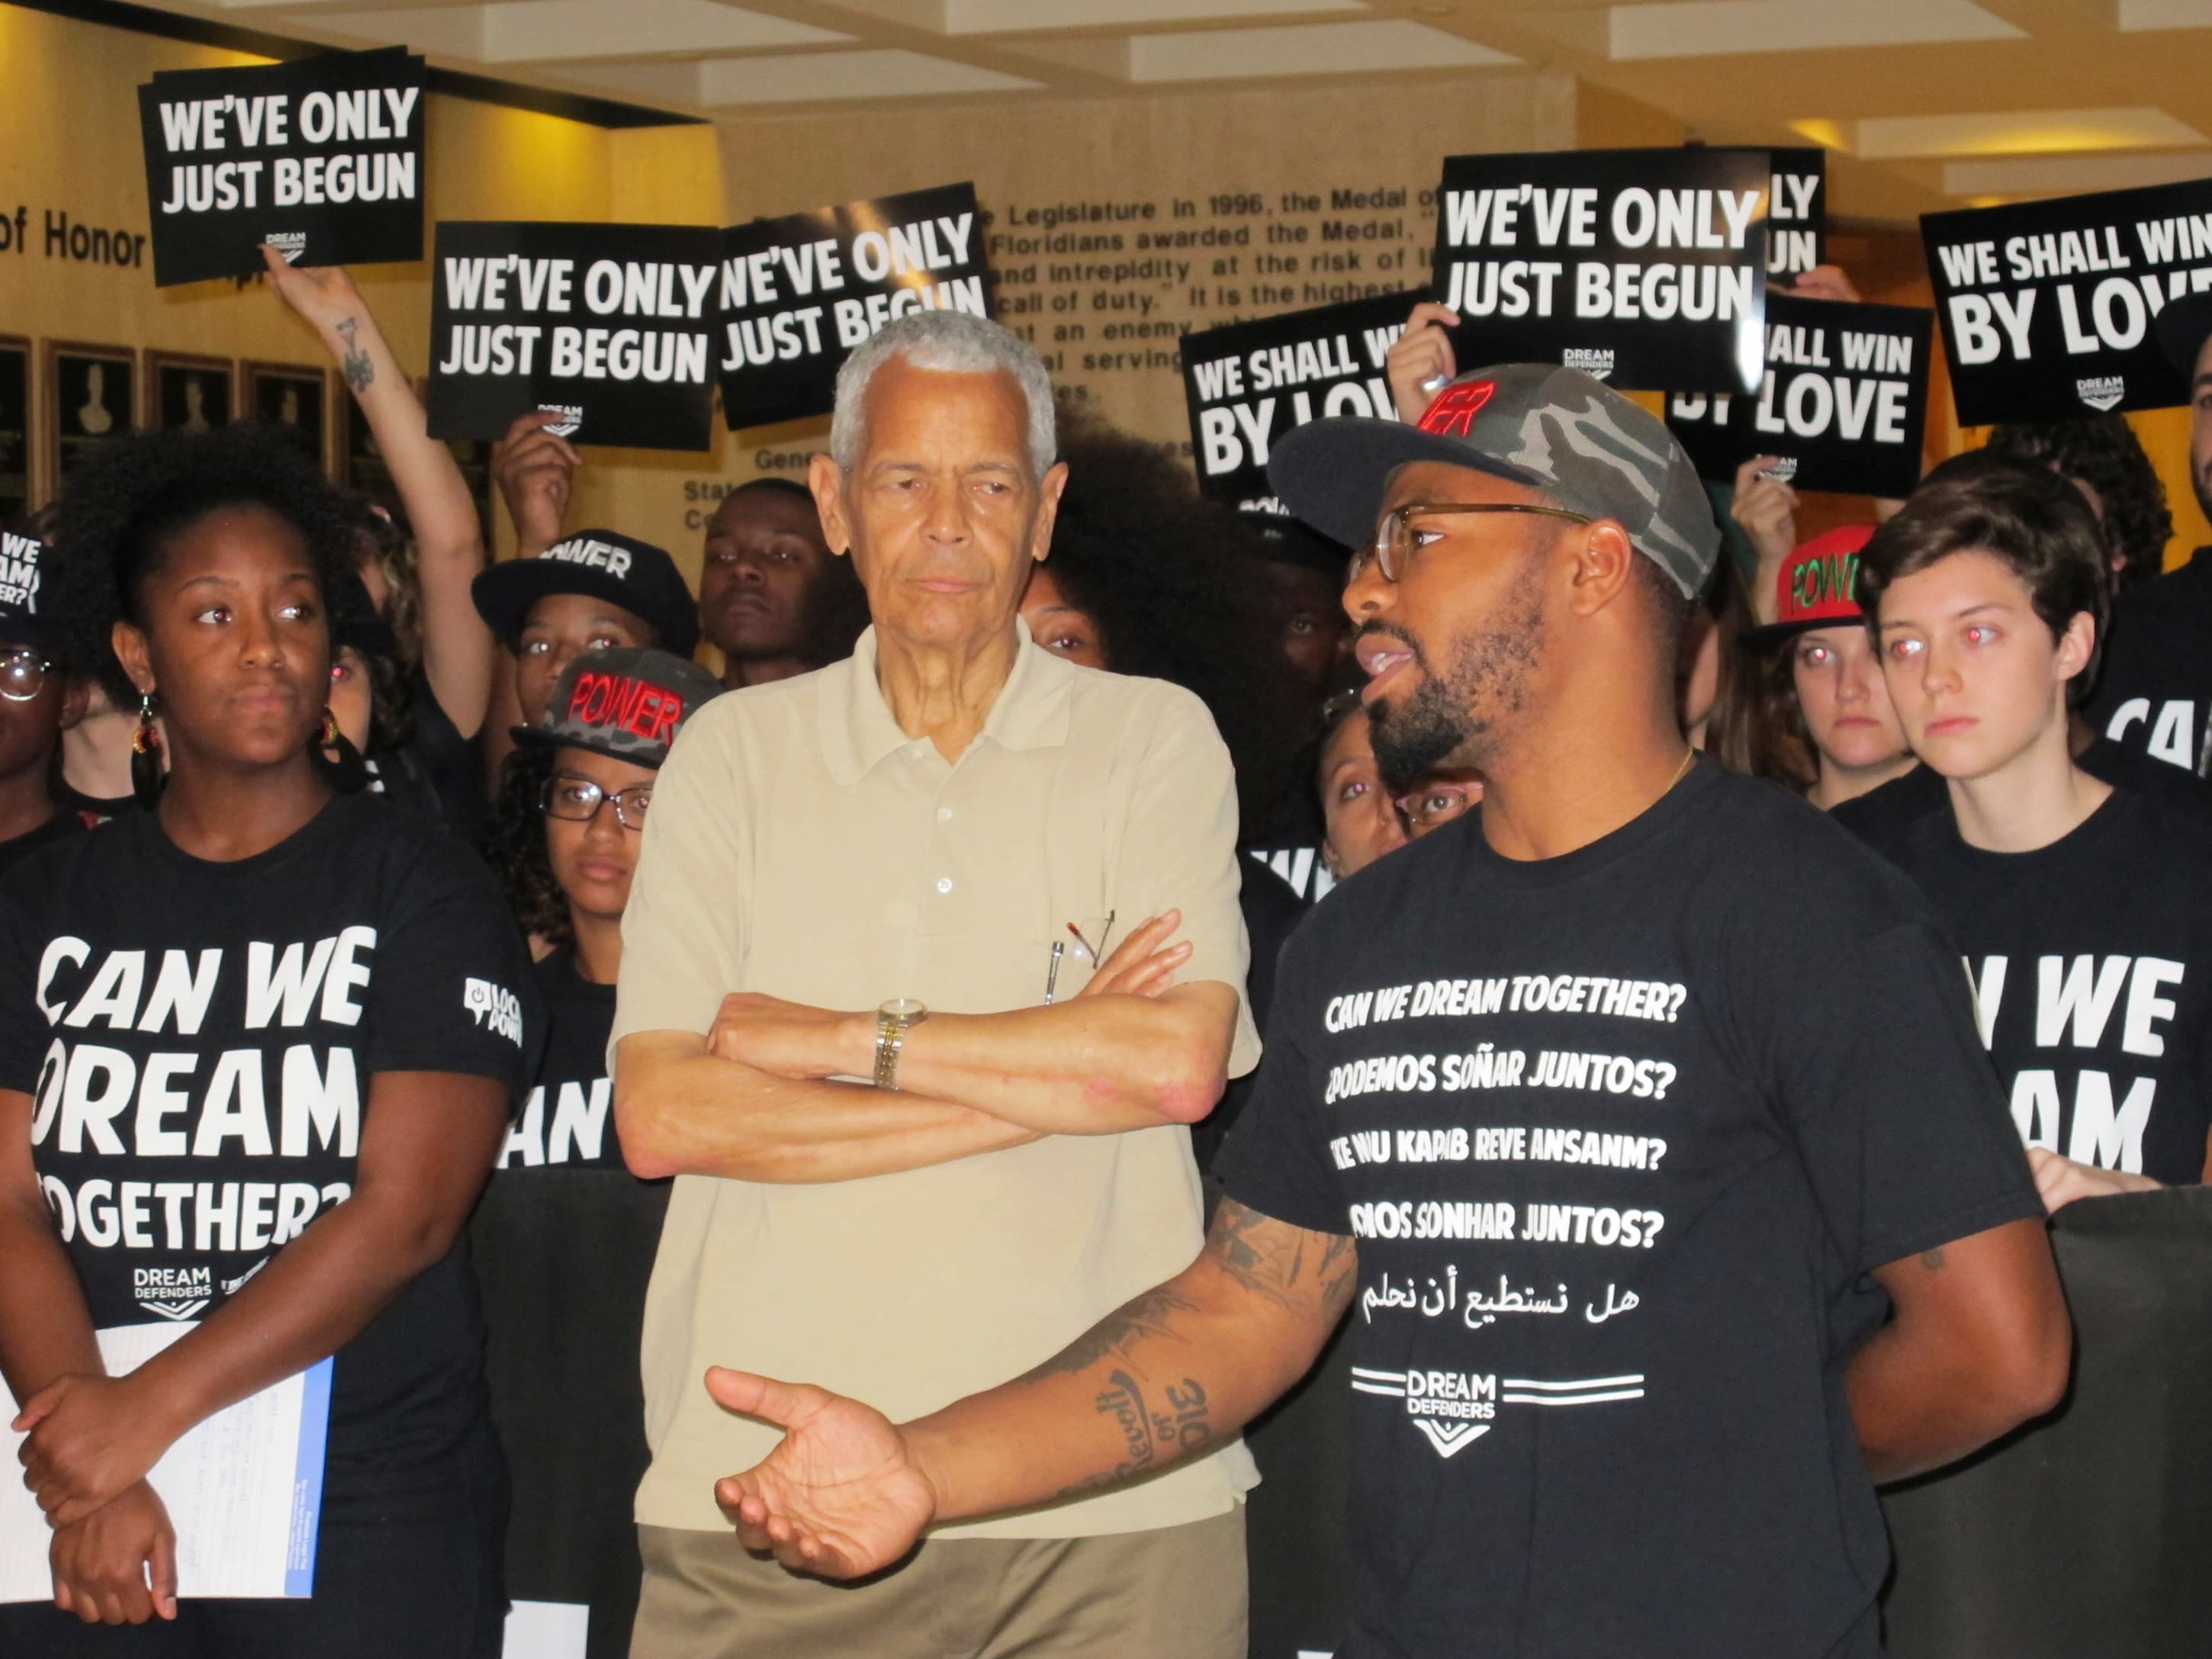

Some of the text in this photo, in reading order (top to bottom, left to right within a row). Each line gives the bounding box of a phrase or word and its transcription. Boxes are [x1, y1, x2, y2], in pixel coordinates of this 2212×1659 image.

[160, 87, 419, 152] WE'VE ONLY
[162, 152, 416, 214] JUST BEGUN
[1008, 201, 1156, 229] Legislature
[1172, 198, 1196, 217] in
[1208, 192, 1273, 217] 1996,
[1281, 192, 1321, 213] the
[1331, 186, 1407, 210] Medal
[1770, 173, 1820, 220] LY
[0, 205, 146, 268] of Honor
[265, 232, 306, 244] DREAM
[992, 217, 1414, 255] Floridians awarded the Medal,
[1445, 183, 1760, 249] WE'VE ONLY
[852, 212, 973, 282] ONLY
[992, 262, 1037, 285] and
[1050, 258, 1190, 285] intrepidity
[1212, 256, 1238, 276] at
[1256, 253, 1298, 273] the
[1310, 249, 1362, 272] risk
[1377, 246, 1405, 270] of
[1937, 213, 2212, 288] WE SHALL WIN
[444, 253, 717, 319] WE'VE ONLY
[1000, 292, 1043, 313] call
[1052, 291, 1078, 311] of
[1190, 287, 1206, 306] It
[1217, 285, 1240, 306] is
[1252, 285, 1294, 304] the
[1447, 261, 1754, 321] JUST BEGUN
[721, 306, 824, 371] JUST
[1053, 323, 1085, 341] an
[1104, 320, 1191, 340] enemy
[1947, 267, 2212, 365] BY LOV
[440, 324, 709, 384] JUST BEGUN
[1083, 348, 1184, 373] serving
[1193, 355, 1245, 402] WE
[1249, 334, 1360, 392] SHALL
[1563, 348, 1615, 360] DREAM
[1765, 323, 1913, 375] ALL WIN
[1757, 368, 1908, 443] LOVE
[2076, 375, 2124, 390] DREAM
[1199, 397, 1276, 476] BY
[683, 480, 733, 501] Stat
[0, 555, 35, 590] AM
[2, 532, 42, 564] WE
[539, 538, 632, 580] OWER
[0, 583, 28, 605] ER?
[569, 671, 684, 746] POWER
[2105, 696, 2212, 779] CA
[36, 924, 378, 1035] CAN WE
[1324, 975, 1688, 1033] CAN WE DREAM TOGETHER?
[2035, 953, 2185, 1057] WE
[31, 1037, 360, 1159] DREAM
[1442, 1042, 1526, 1092] SOÑAR
[1527, 1050, 1677, 1100] JUNTOS?
[495, 1077, 612, 1169] AN
[1475, 1127, 1526, 1162] REVE
[1529, 1127, 1668, 1171] ANSANM?
[2010, 1069, 2157, 1175] AM
[37, 1172, 352, 1252] OGETHER
[1413, 1201, 1516, 1240] SONHAR
[1522, 1204, 1666, 1249] JUNTOS?
[134, 1266, 211, 1287] DREAM
[134, 1284, 212, 1300] DEFENDERS
[1362, 1264, 1641, 1329] هل نستطيع أن نحلم
[1406, 1370, 1497, 1401] DREAM
[1407, 1397, 1496, 1419] DEFENDERS
